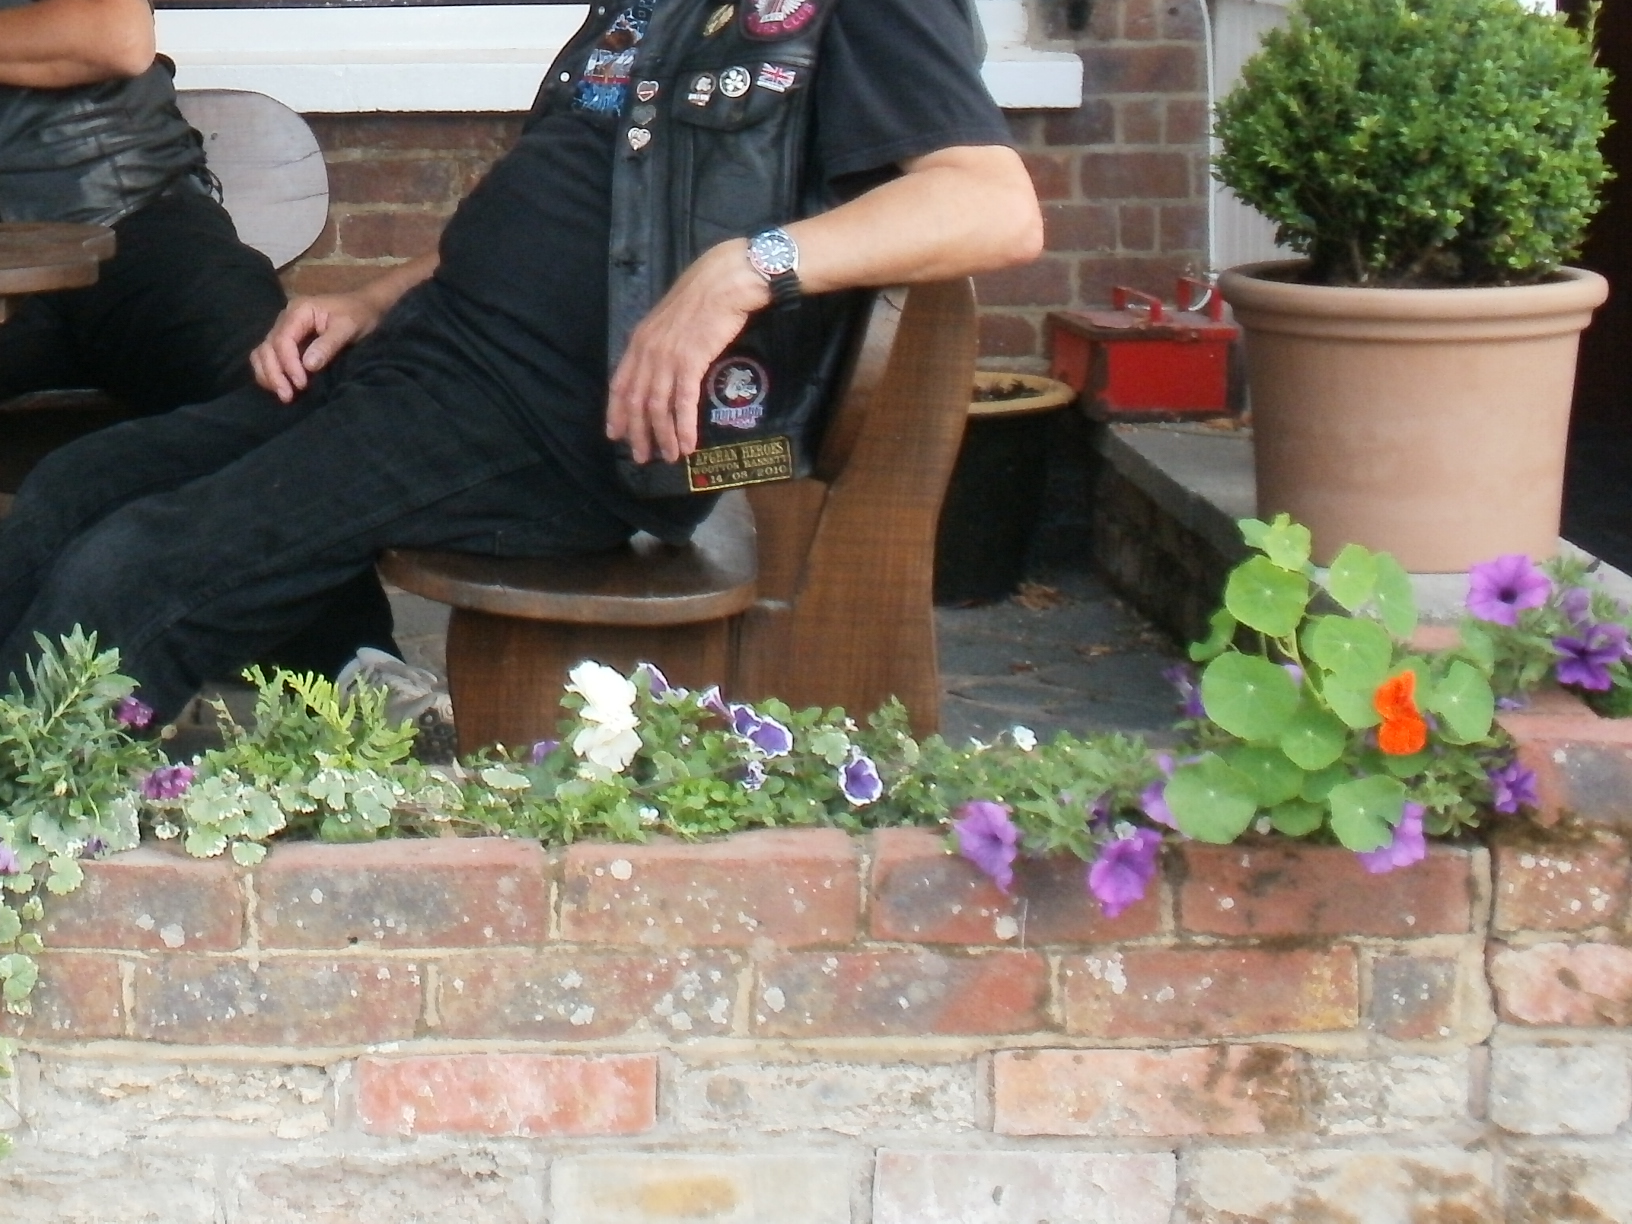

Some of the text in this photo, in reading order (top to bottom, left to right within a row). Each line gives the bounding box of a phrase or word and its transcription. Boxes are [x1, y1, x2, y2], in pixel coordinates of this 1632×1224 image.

[695, 441, 784, 466] AFGHAN HEROES
[691, 461, 740, 475] WOOTTON
